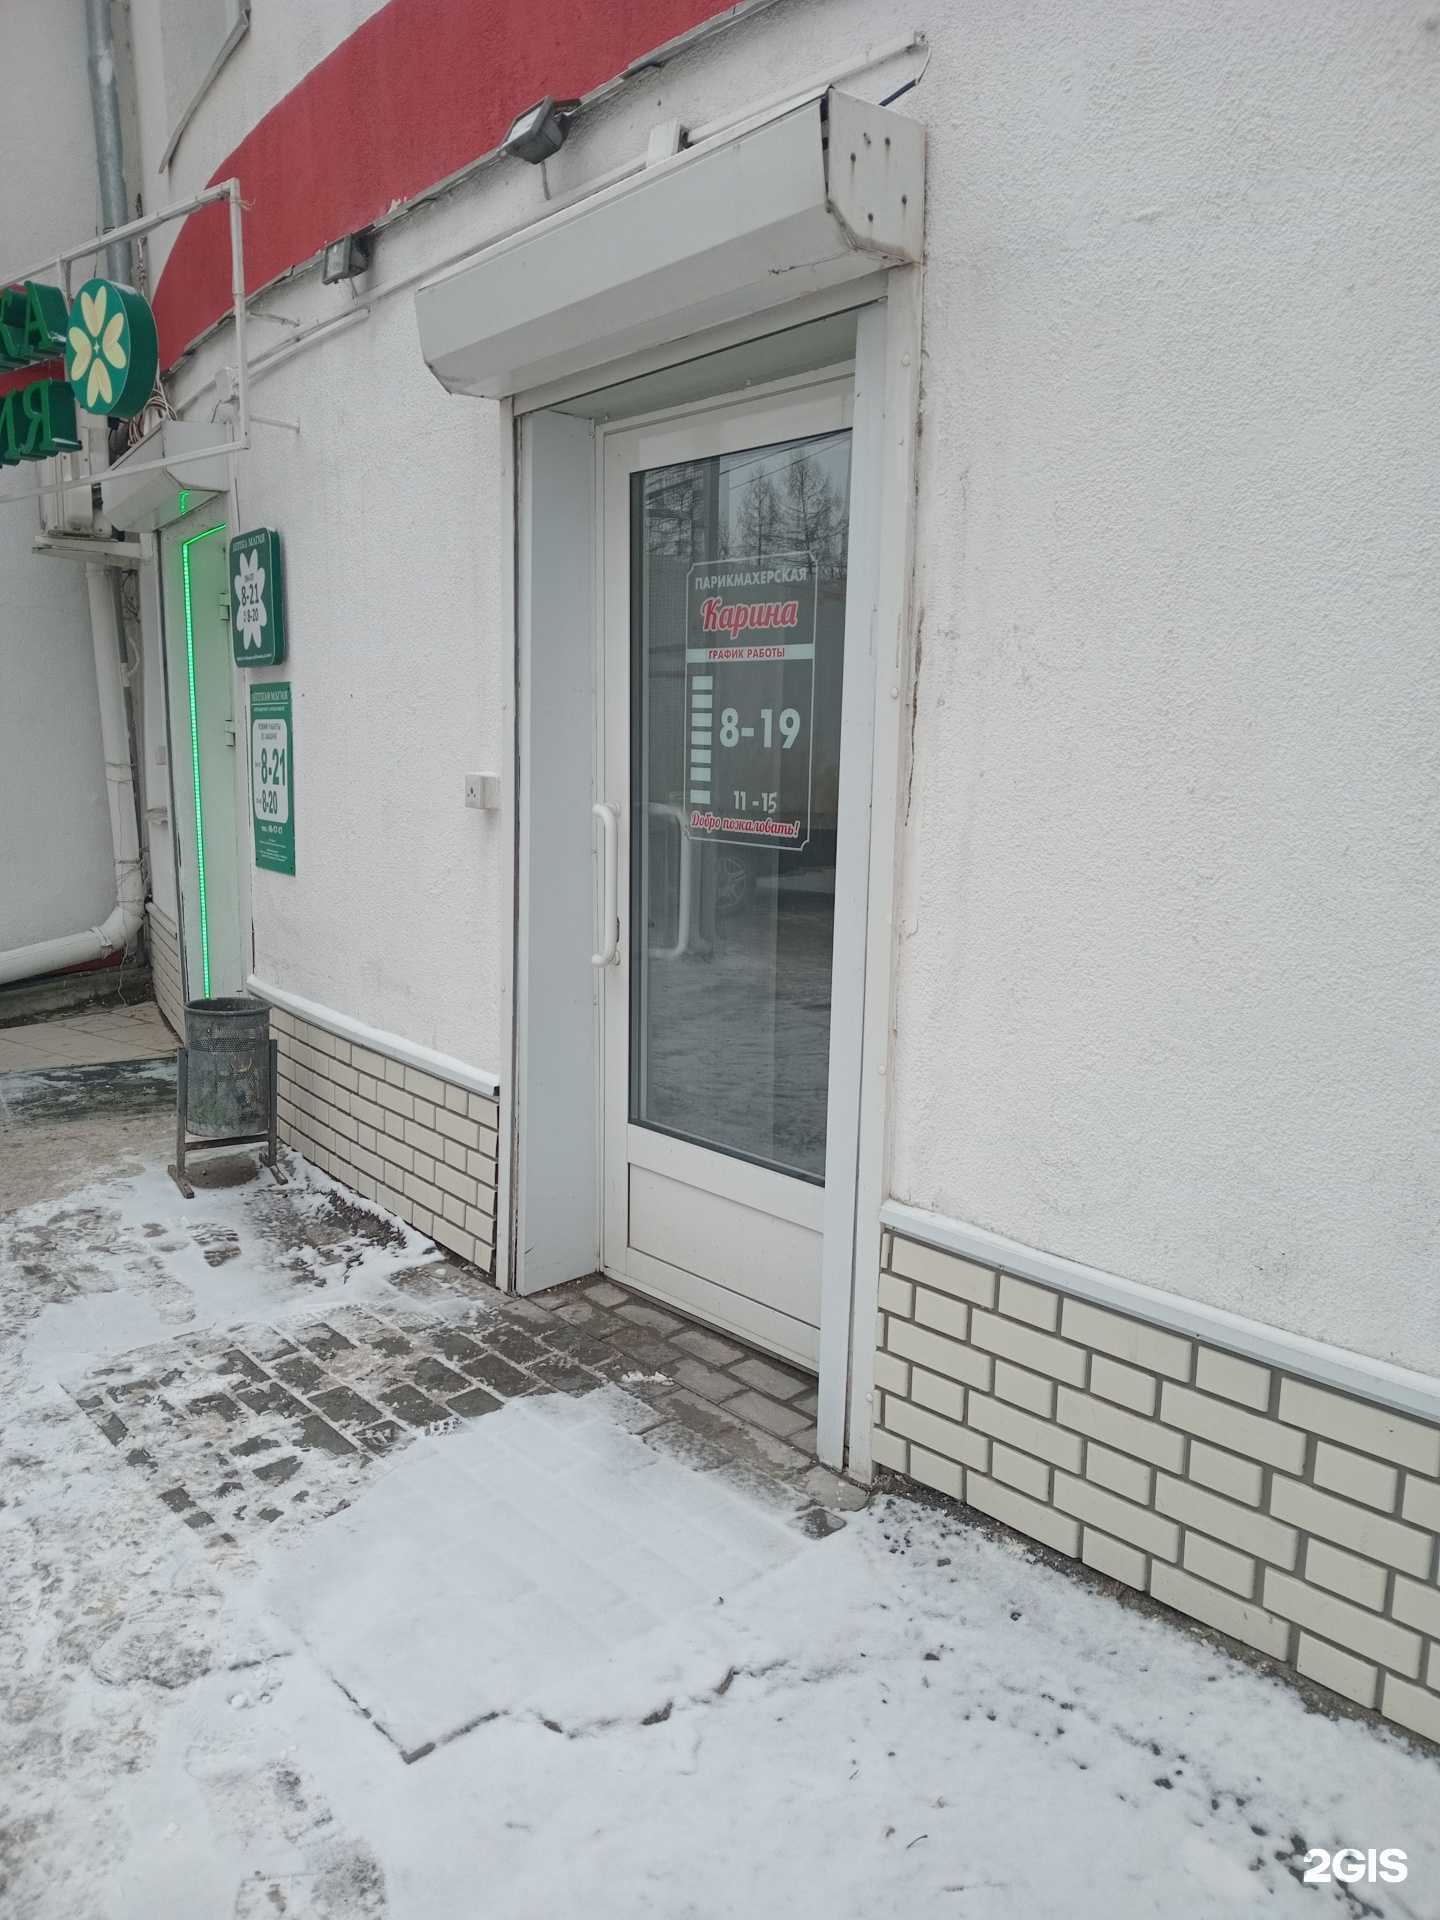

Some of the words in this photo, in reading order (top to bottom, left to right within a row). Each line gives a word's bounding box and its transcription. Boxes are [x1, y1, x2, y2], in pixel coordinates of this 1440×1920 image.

[695, 567, 807, 590] ПАРИКМАХЕРСКАЯ
[241, 583, 260, 606] 8-21
[701, 597, 799, 640] Карина
[708, 648, 744, 660] ГРАФИК
[746, 647, 785, 659] РАБОТЫ
[720, 708, 801, 749] 8-19
[261, 748, 286, 786] 8-21
[262, 790, 278, 815] 8-20
[691, 810, 722, 833] Добро
[721, 817, 800, 838] пожаловать!
